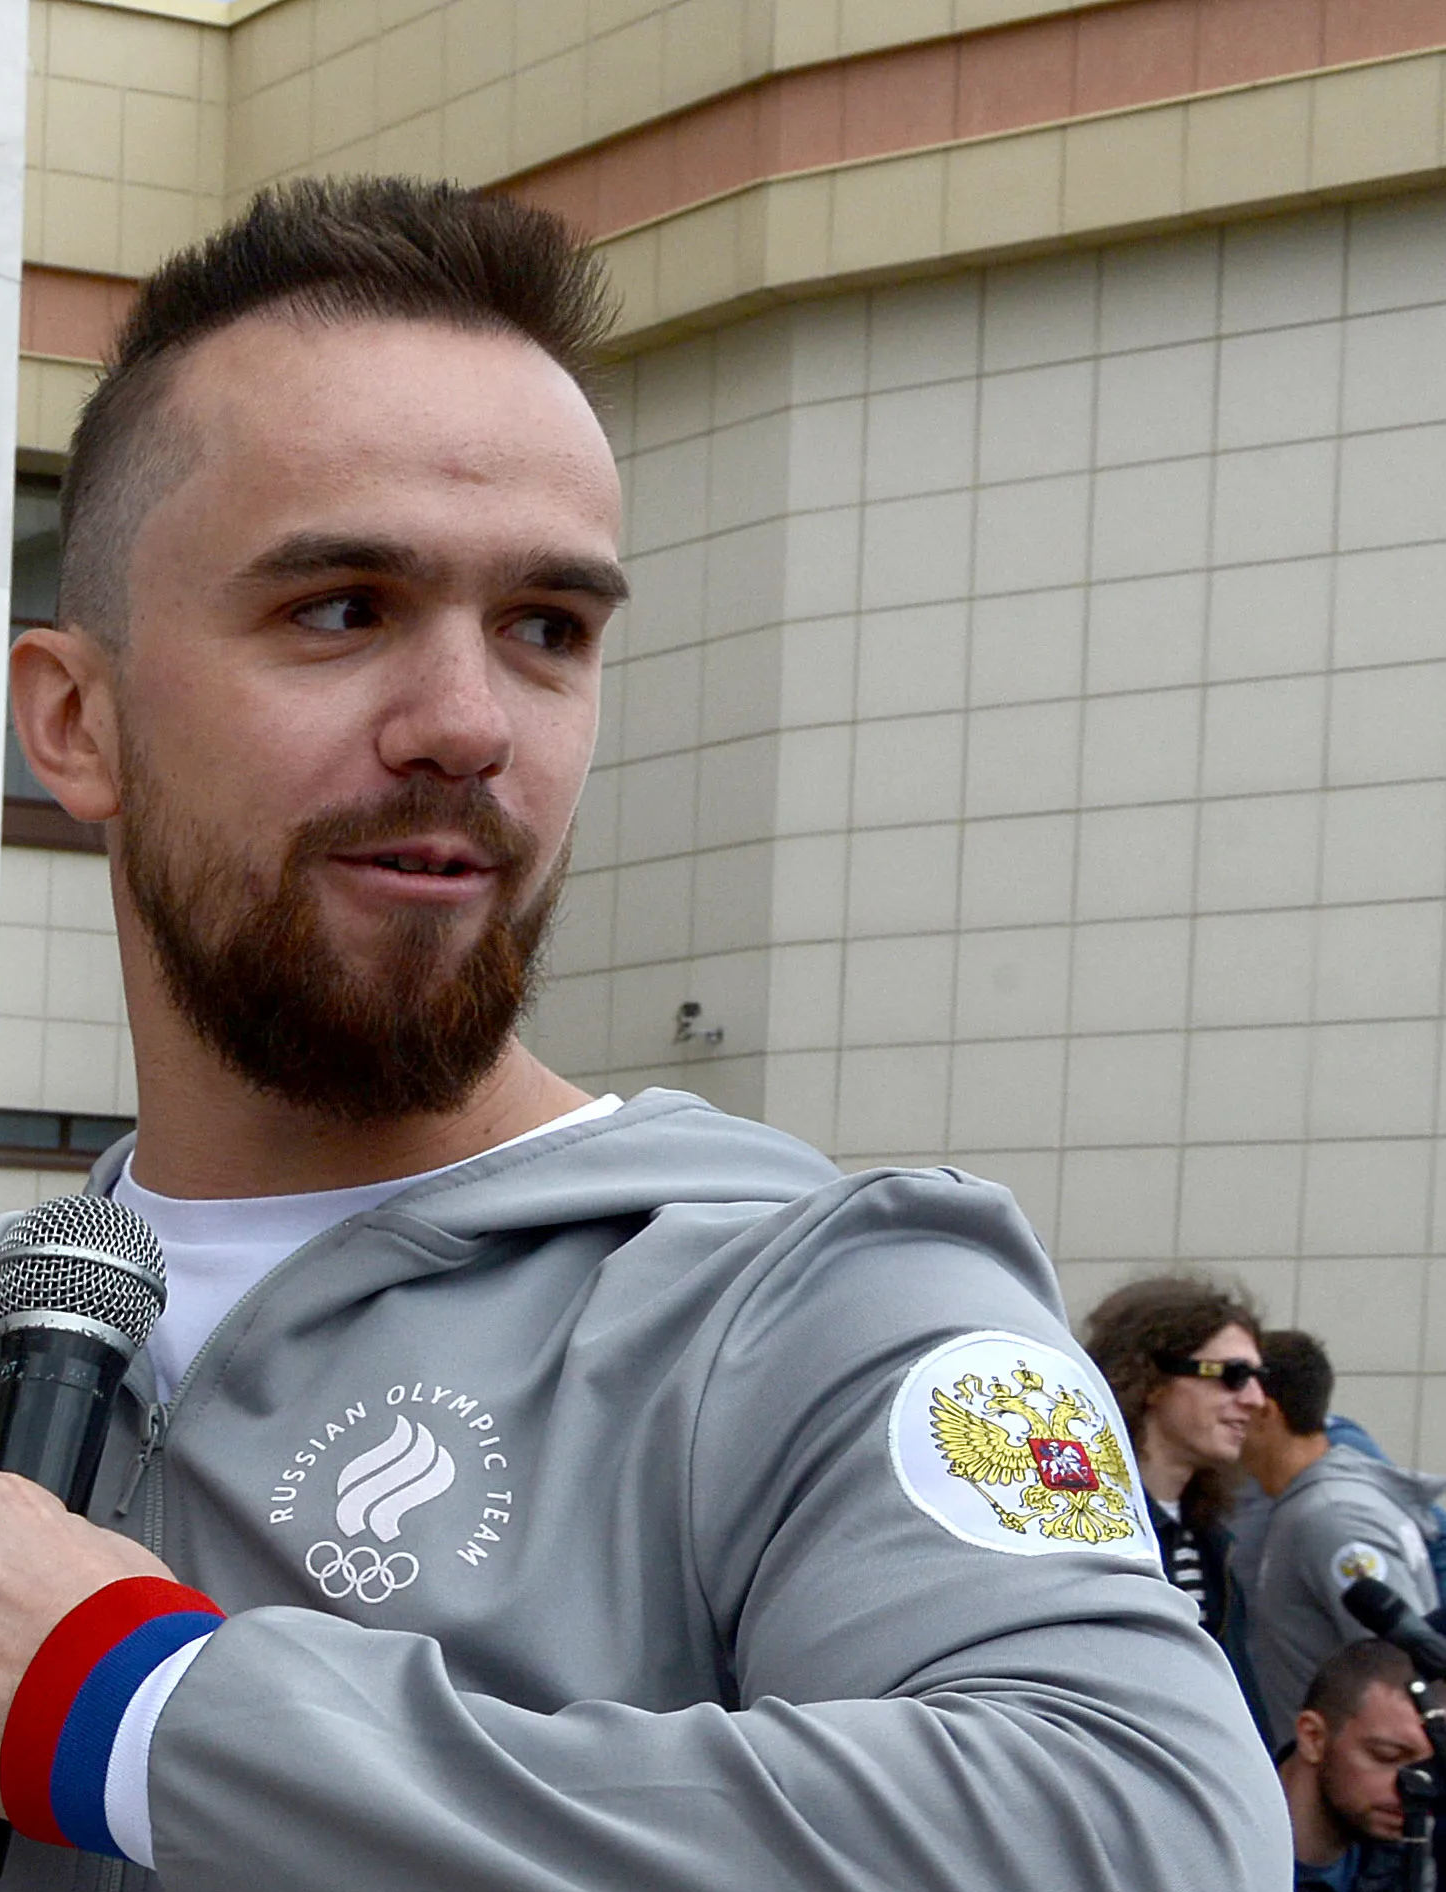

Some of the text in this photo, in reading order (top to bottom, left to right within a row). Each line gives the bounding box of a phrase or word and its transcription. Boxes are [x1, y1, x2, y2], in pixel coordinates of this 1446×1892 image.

[269, 1382, 513, 1567] RUSSIAN OLYMPIC TEAM
